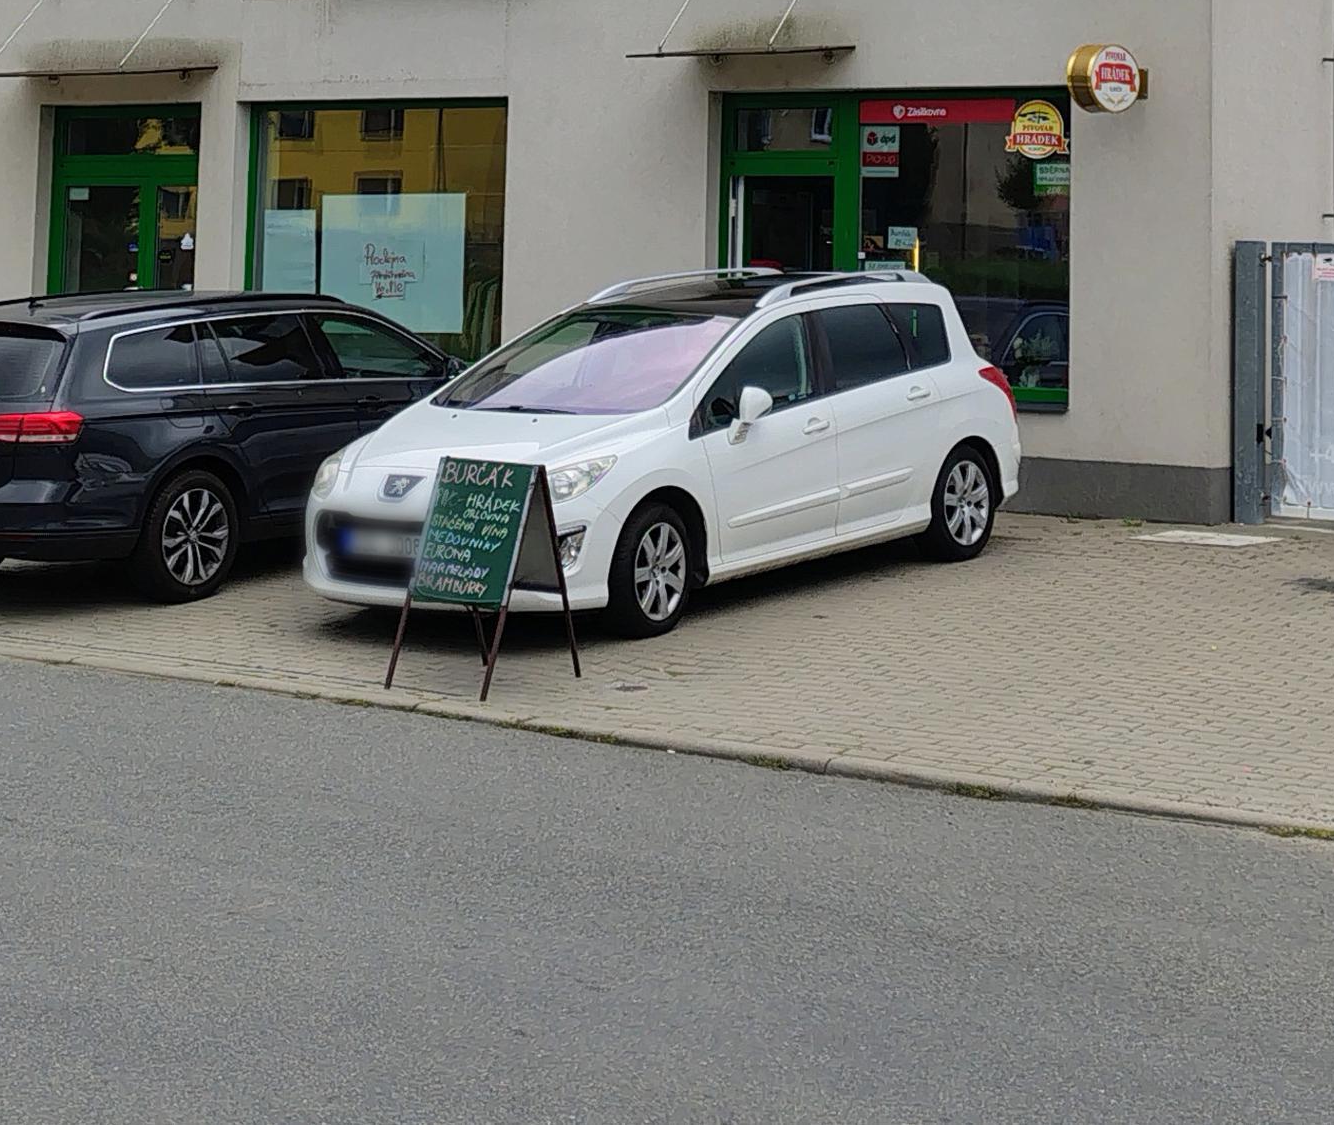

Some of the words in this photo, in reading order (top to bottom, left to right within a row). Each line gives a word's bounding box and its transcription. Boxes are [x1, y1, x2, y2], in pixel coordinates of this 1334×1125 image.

[1100, 66, 1132, 81] HRÁDEK
[1022, 124, 1054, 132] PIVOVAR
[1015, 133, 1059, 146] HRÁDEK
[442, 461, 514, 488] BURČÁK
[466, 491, 520, 512] HRÁDEK
[423, 541, 472, 563] EURONA
